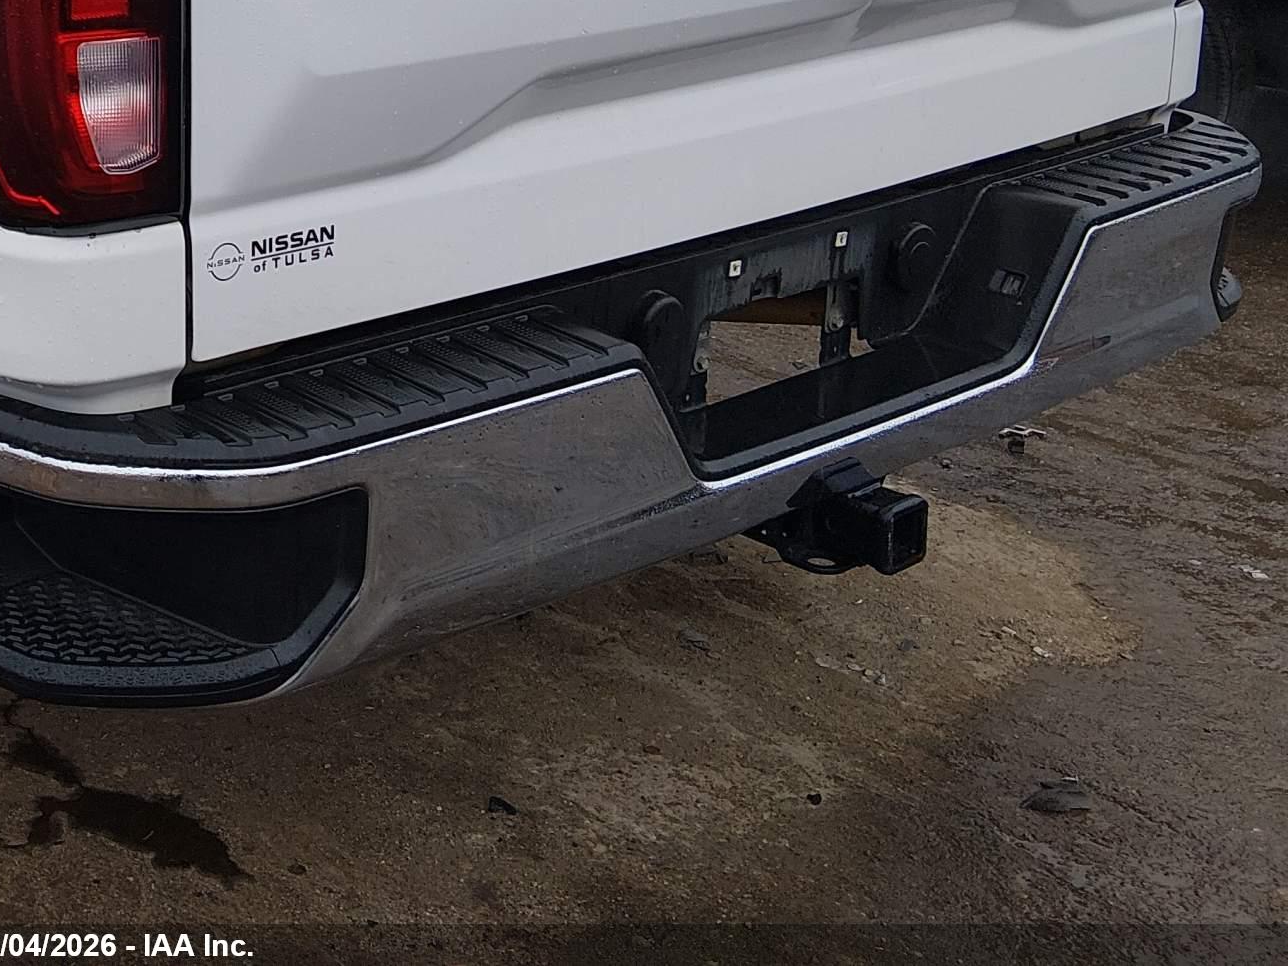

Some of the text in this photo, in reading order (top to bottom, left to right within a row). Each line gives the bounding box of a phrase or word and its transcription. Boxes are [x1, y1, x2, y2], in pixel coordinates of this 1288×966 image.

[250, 225, 335, 257] NISSAN
[207, 254, 245, 270] NISSAN
[253, 246, 334, 273] of TULSA
